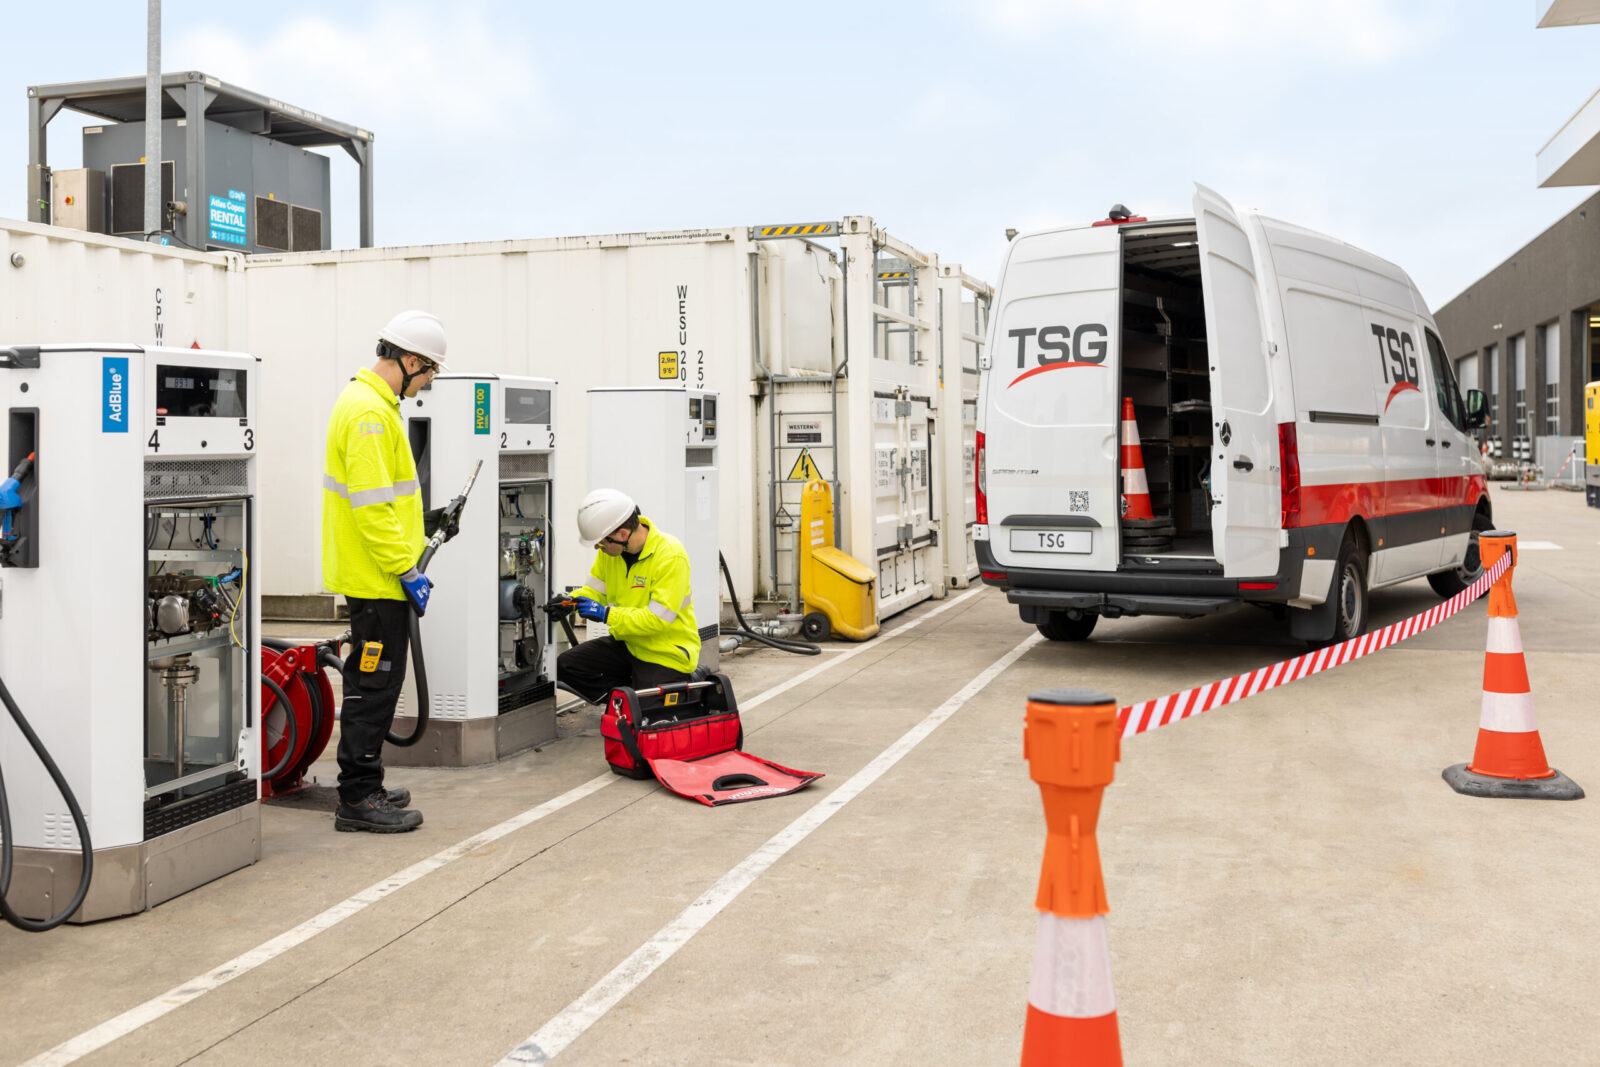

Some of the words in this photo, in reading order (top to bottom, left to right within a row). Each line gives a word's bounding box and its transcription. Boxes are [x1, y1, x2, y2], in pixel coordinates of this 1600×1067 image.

[210, 197, 226, 209] Atlas
[226, 201, 246, 214] Copco
[210, 208, 246, 228] RENTAL
[676, 284, 688, 346] WESU
[1008, 323, 1108, 369] TSG
[1371, 322, 1419, 387] TSG
[476, 388, 485, 405] 100
[357, 422, 385, 434] TSG
[476, 407, 485, 430] HVO
[148, 429, 160, 453] 4
[244, 428, 254, 451] 3
[500, 431, 508, 449] 2
[549, 432, 555, 448] 2
[1038, 532, 1065, 549] TSG
